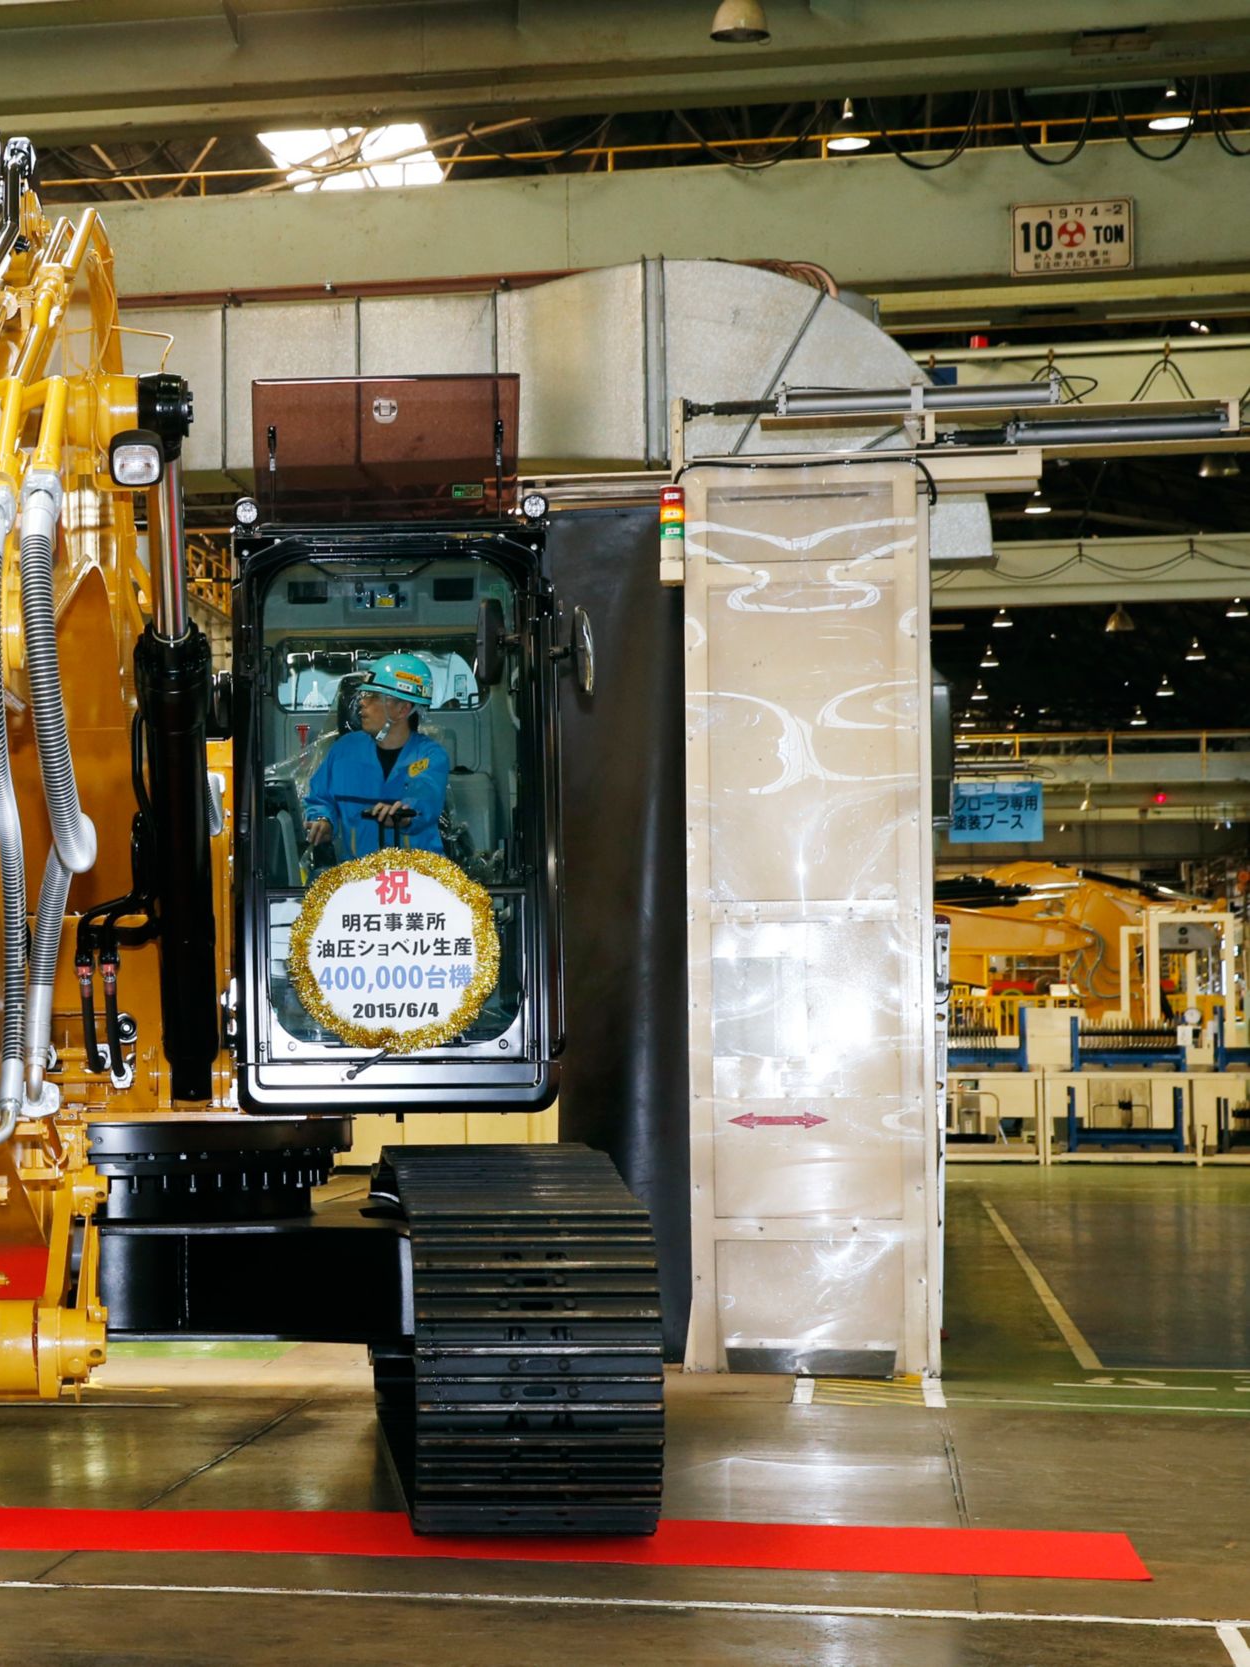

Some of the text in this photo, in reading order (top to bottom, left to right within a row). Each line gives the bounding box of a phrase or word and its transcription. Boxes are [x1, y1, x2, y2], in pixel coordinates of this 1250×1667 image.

[1020, 220, 1125, 254] 10 TON
[954, 795, 1038, 812] クローラ専用
[954, 814, 1024, 830] 塗装ブース
[375, 870, 412, 905] 祝
[342, 912, 446, 932] 明石事業所
[316, 937, 473, 959] 油圧ショベル生産
[318, 964, 473, 994] 400,000台機
[352, 1002, 440, 1019] 2015/6/4
